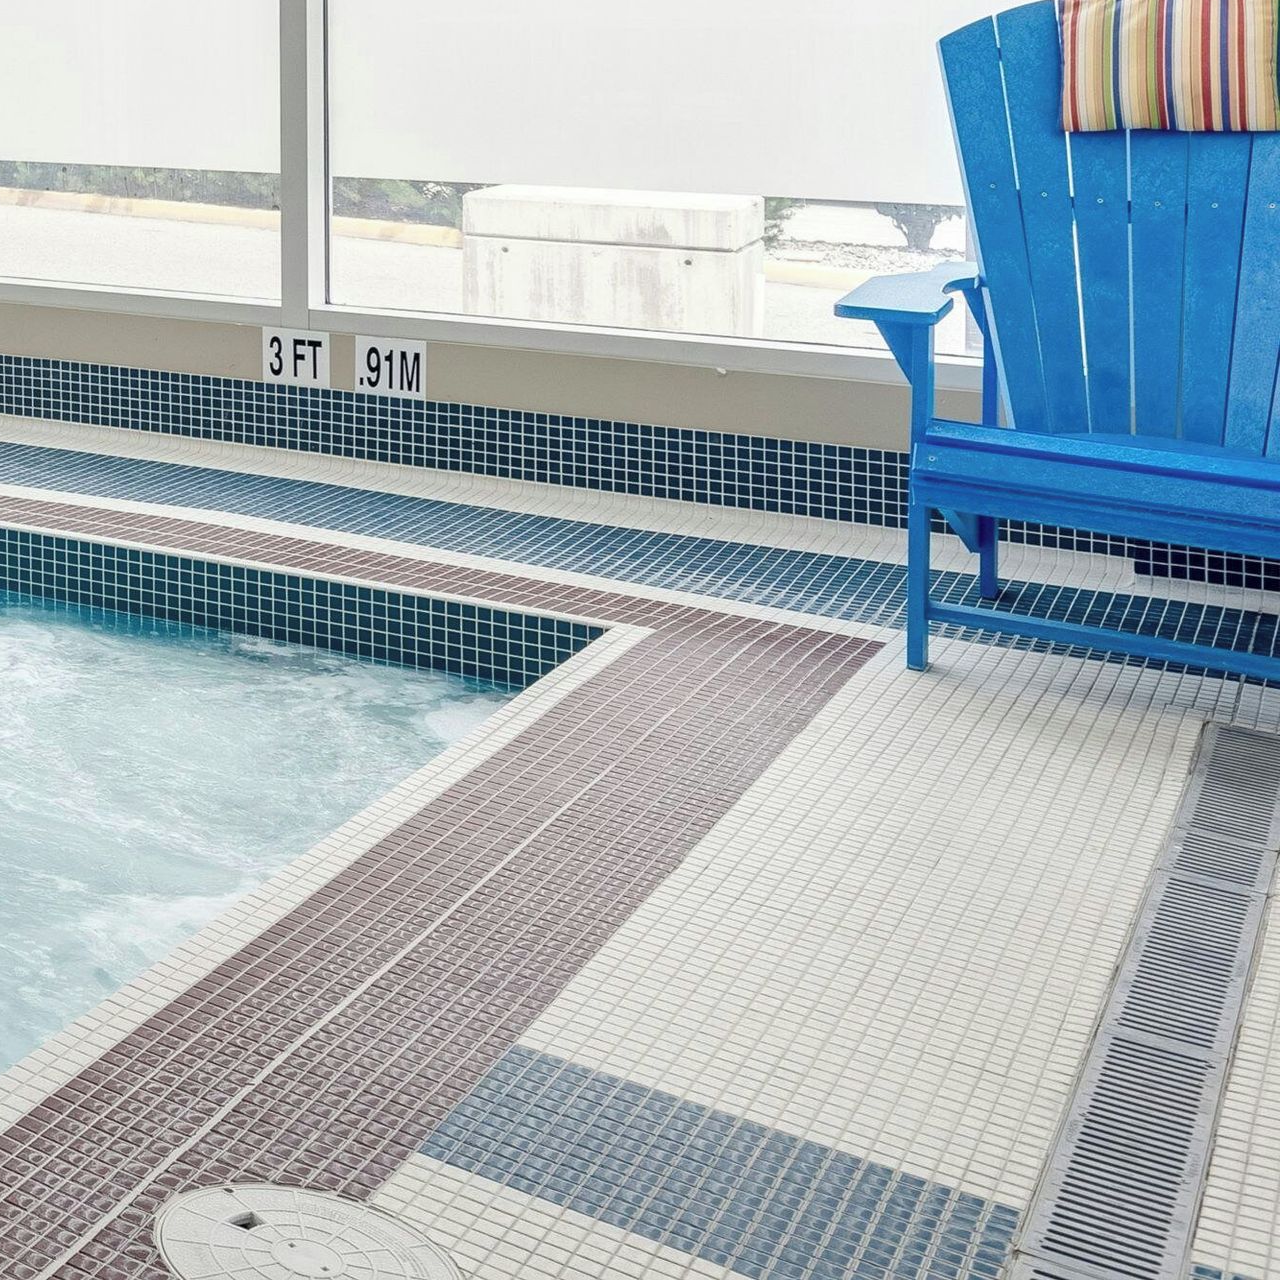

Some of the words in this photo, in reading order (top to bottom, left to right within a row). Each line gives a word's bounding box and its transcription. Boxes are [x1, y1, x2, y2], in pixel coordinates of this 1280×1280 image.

[269, 336, 283, 376] 3
[292, 338, 322, 379] FT
[359, 346, 420, 393] .91M
